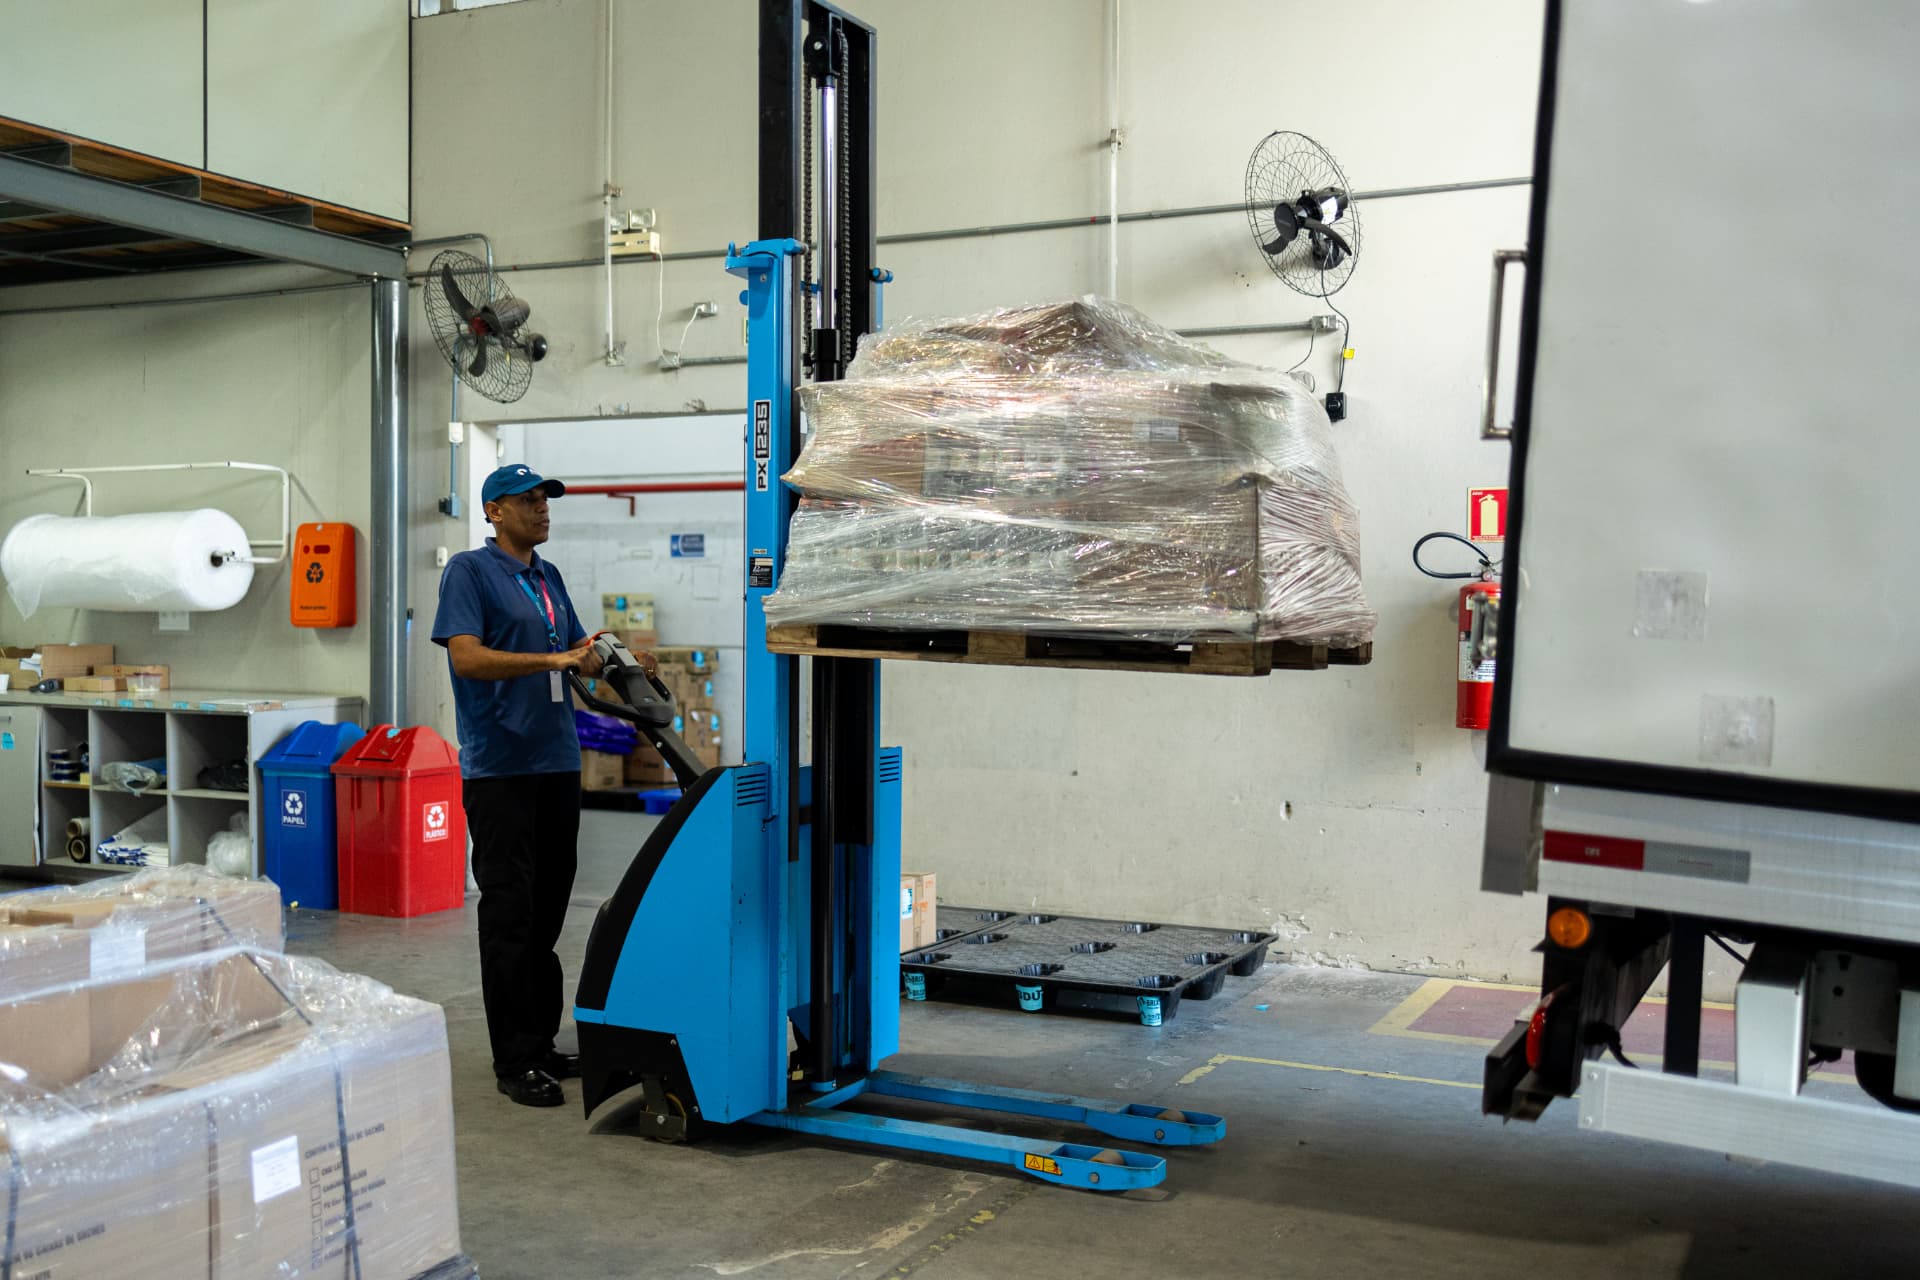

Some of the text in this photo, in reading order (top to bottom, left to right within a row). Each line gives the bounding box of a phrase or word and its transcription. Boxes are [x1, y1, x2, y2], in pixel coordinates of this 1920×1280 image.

[756, 403, 768, 489] PX 1235
[283, 816, 305, 825] PAPEL
